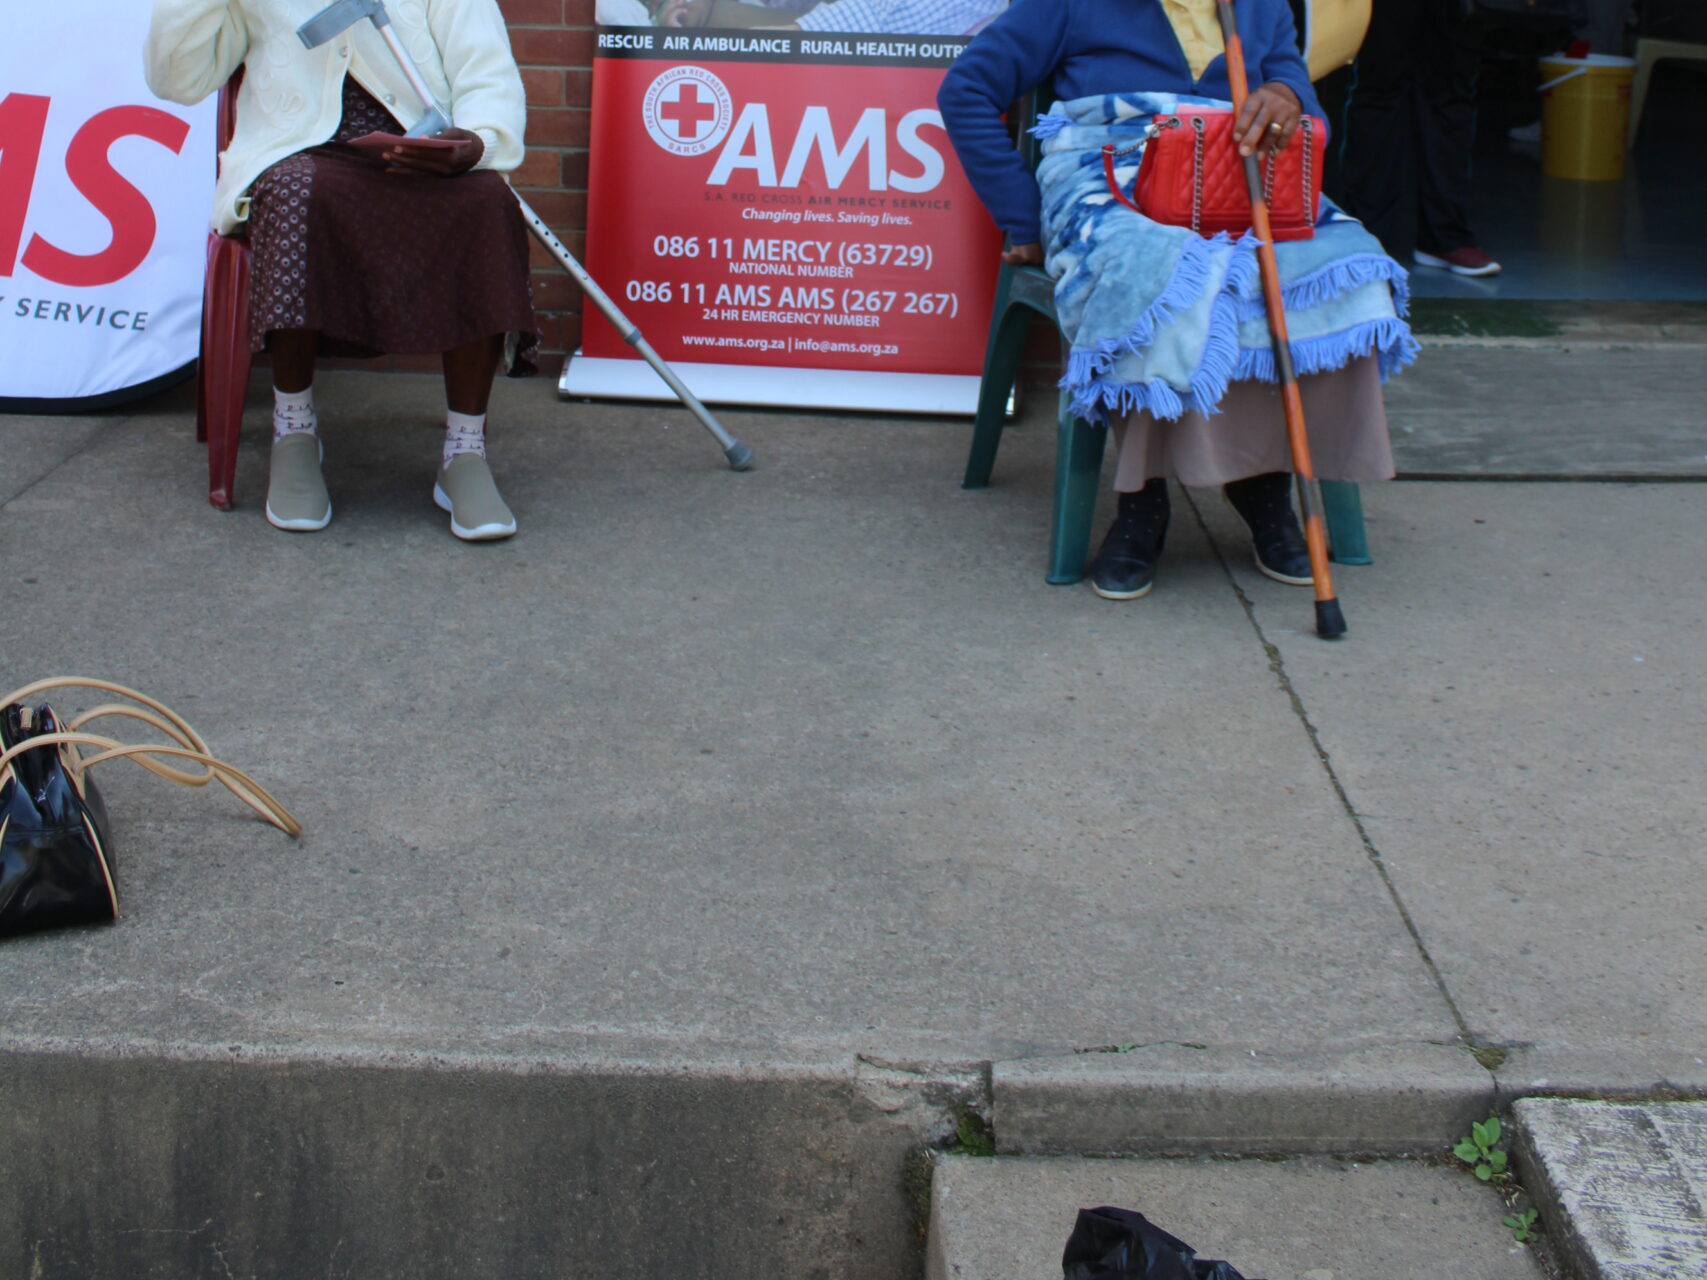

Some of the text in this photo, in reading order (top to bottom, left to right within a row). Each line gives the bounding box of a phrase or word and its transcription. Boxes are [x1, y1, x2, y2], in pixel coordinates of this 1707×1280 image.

[598, 34, 968, 58] RESCUE AIR AMBULANCE RURAL HEALTH OUTR
[668, 142, 706, 153] SARCS
[706, 102, 947, 193] AMS
[0, 92, 191, 287] S
[732, 193, 757, 203] RED
[761, 193, 802, 205] CROSS
[808, 195, 832, 206] AIR
[838, 197, 888, 208] MERCY
[892, 198, 952, 210] SERVICE
[742, 208, 913, 227] Changing lives. Saving lives.
[653, 235, 933, 271] 086 11 MERCY (63729)
[729, 262, 854, 278] NATIONAL NUMBER
[626, 280, 958, 319] 086 11 AMS AMS (267 267)
[15, 297, 149, 331] SERVICE
[702, 308, 880, 327] 24 HR EMERGENCY NUMBER
[682, 335, 785, 351] www.ams.org.za
[795, 338, 899, 356] info@ams.org.za
